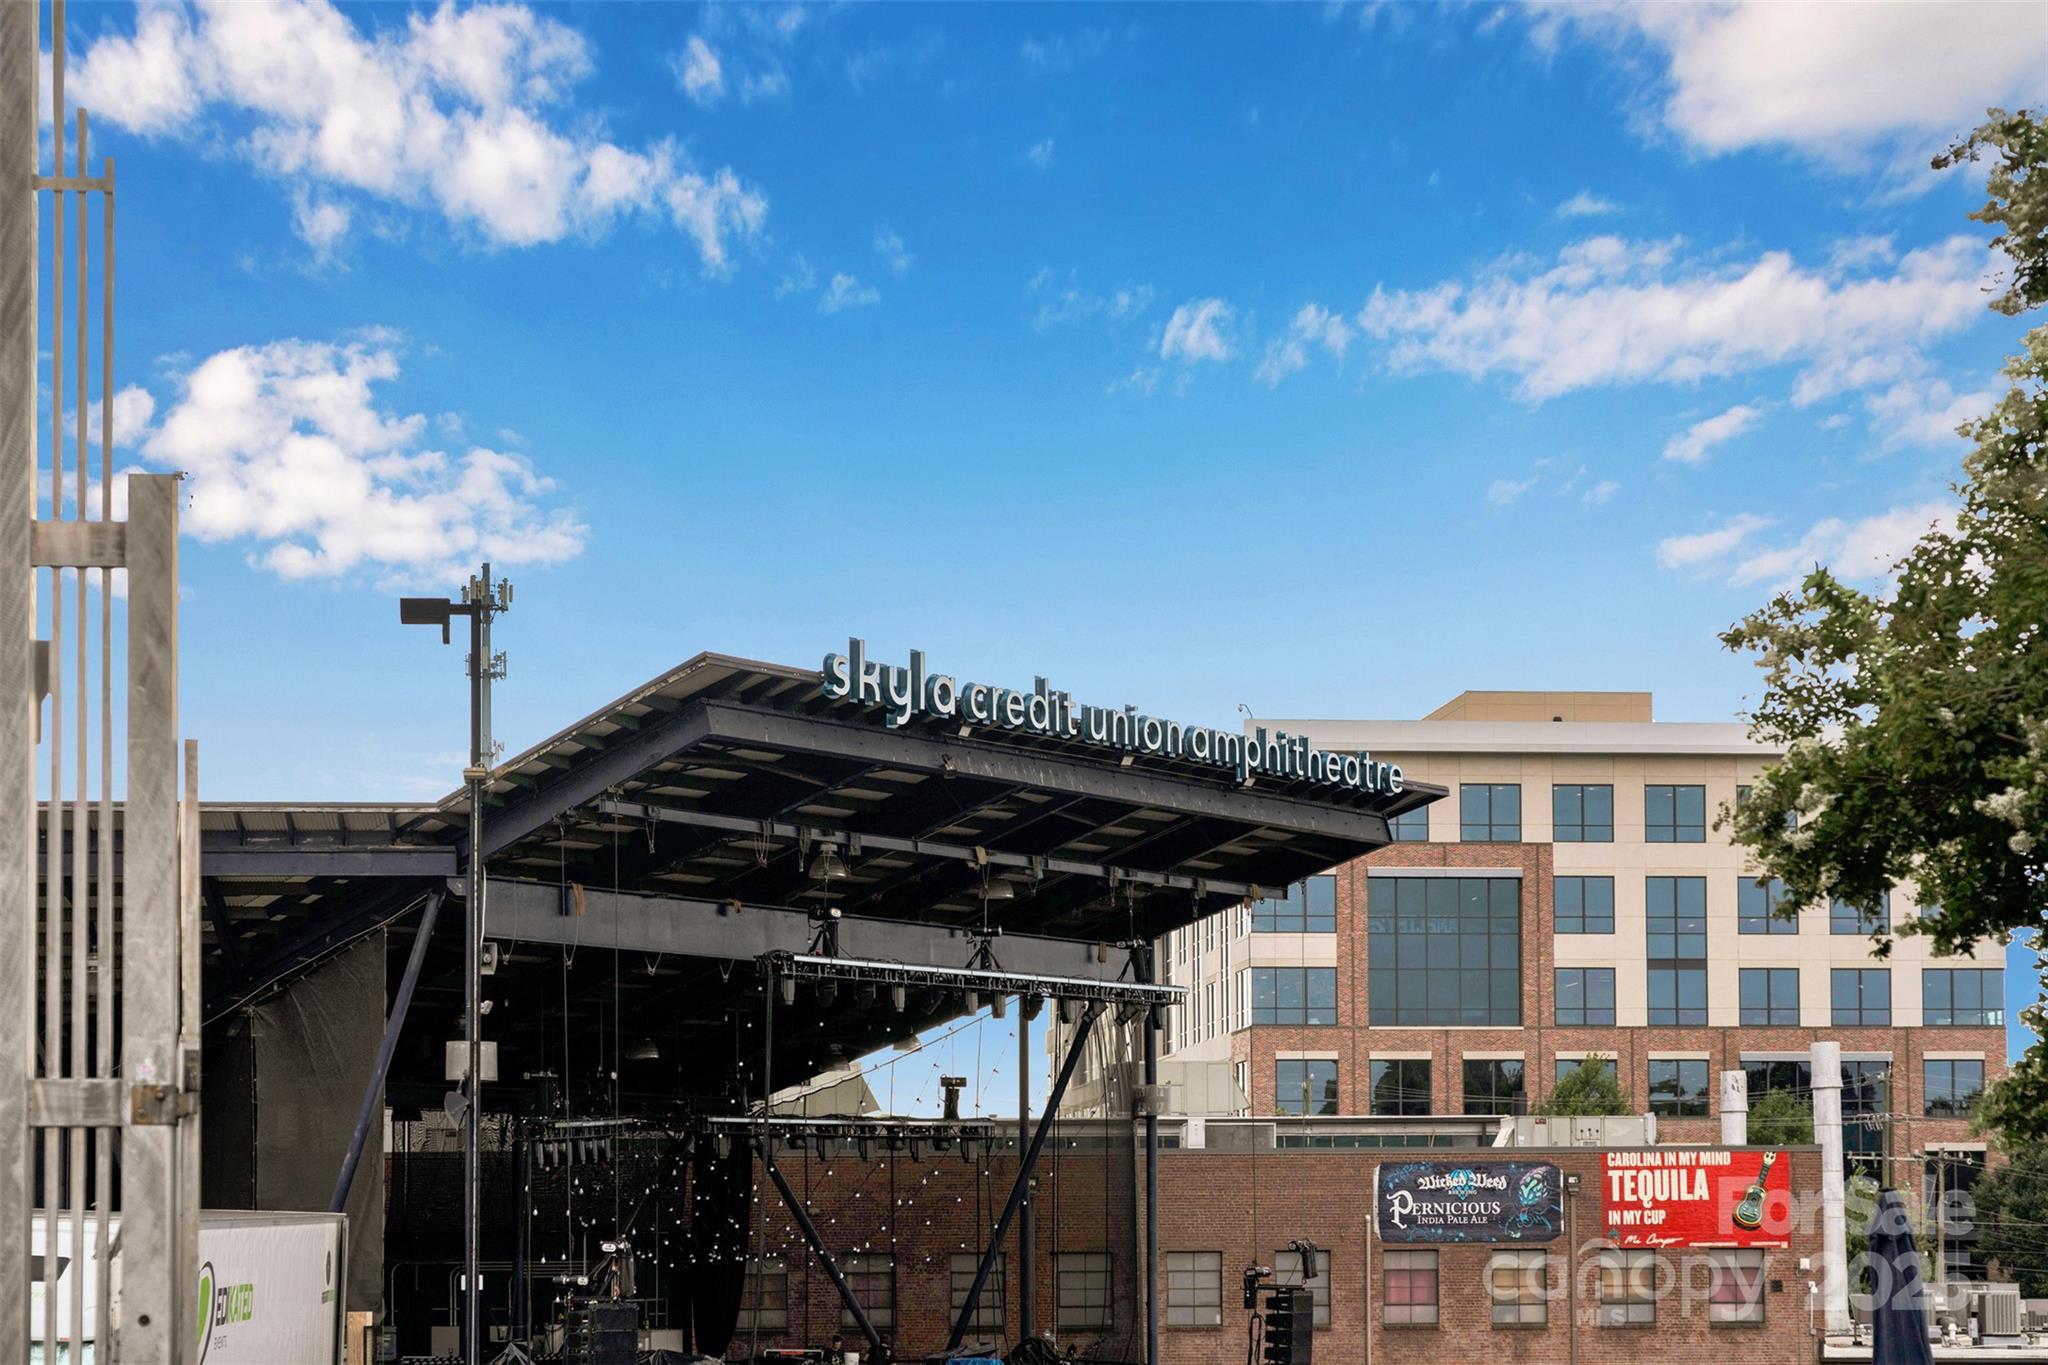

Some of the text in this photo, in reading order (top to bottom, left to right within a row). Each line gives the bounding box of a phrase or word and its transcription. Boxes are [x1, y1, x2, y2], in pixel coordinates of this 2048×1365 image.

[824, 637, 1404, 796] skyla credit union amphitheatre
[1607, 1151, 1731, 1167] CAROLINA IN MY MIND
[1418, 1172, 1507, 1190] Wicked Weed
[1607, 1168, 1710, 1208] TEQUILA
[1386, 1190, 1500, 1229] PERNICIOUS
[1608, 1210, 1666, 1225] IN MY CUP
[1417, 1215, 1488, 1224] INDIA PALE ALE
